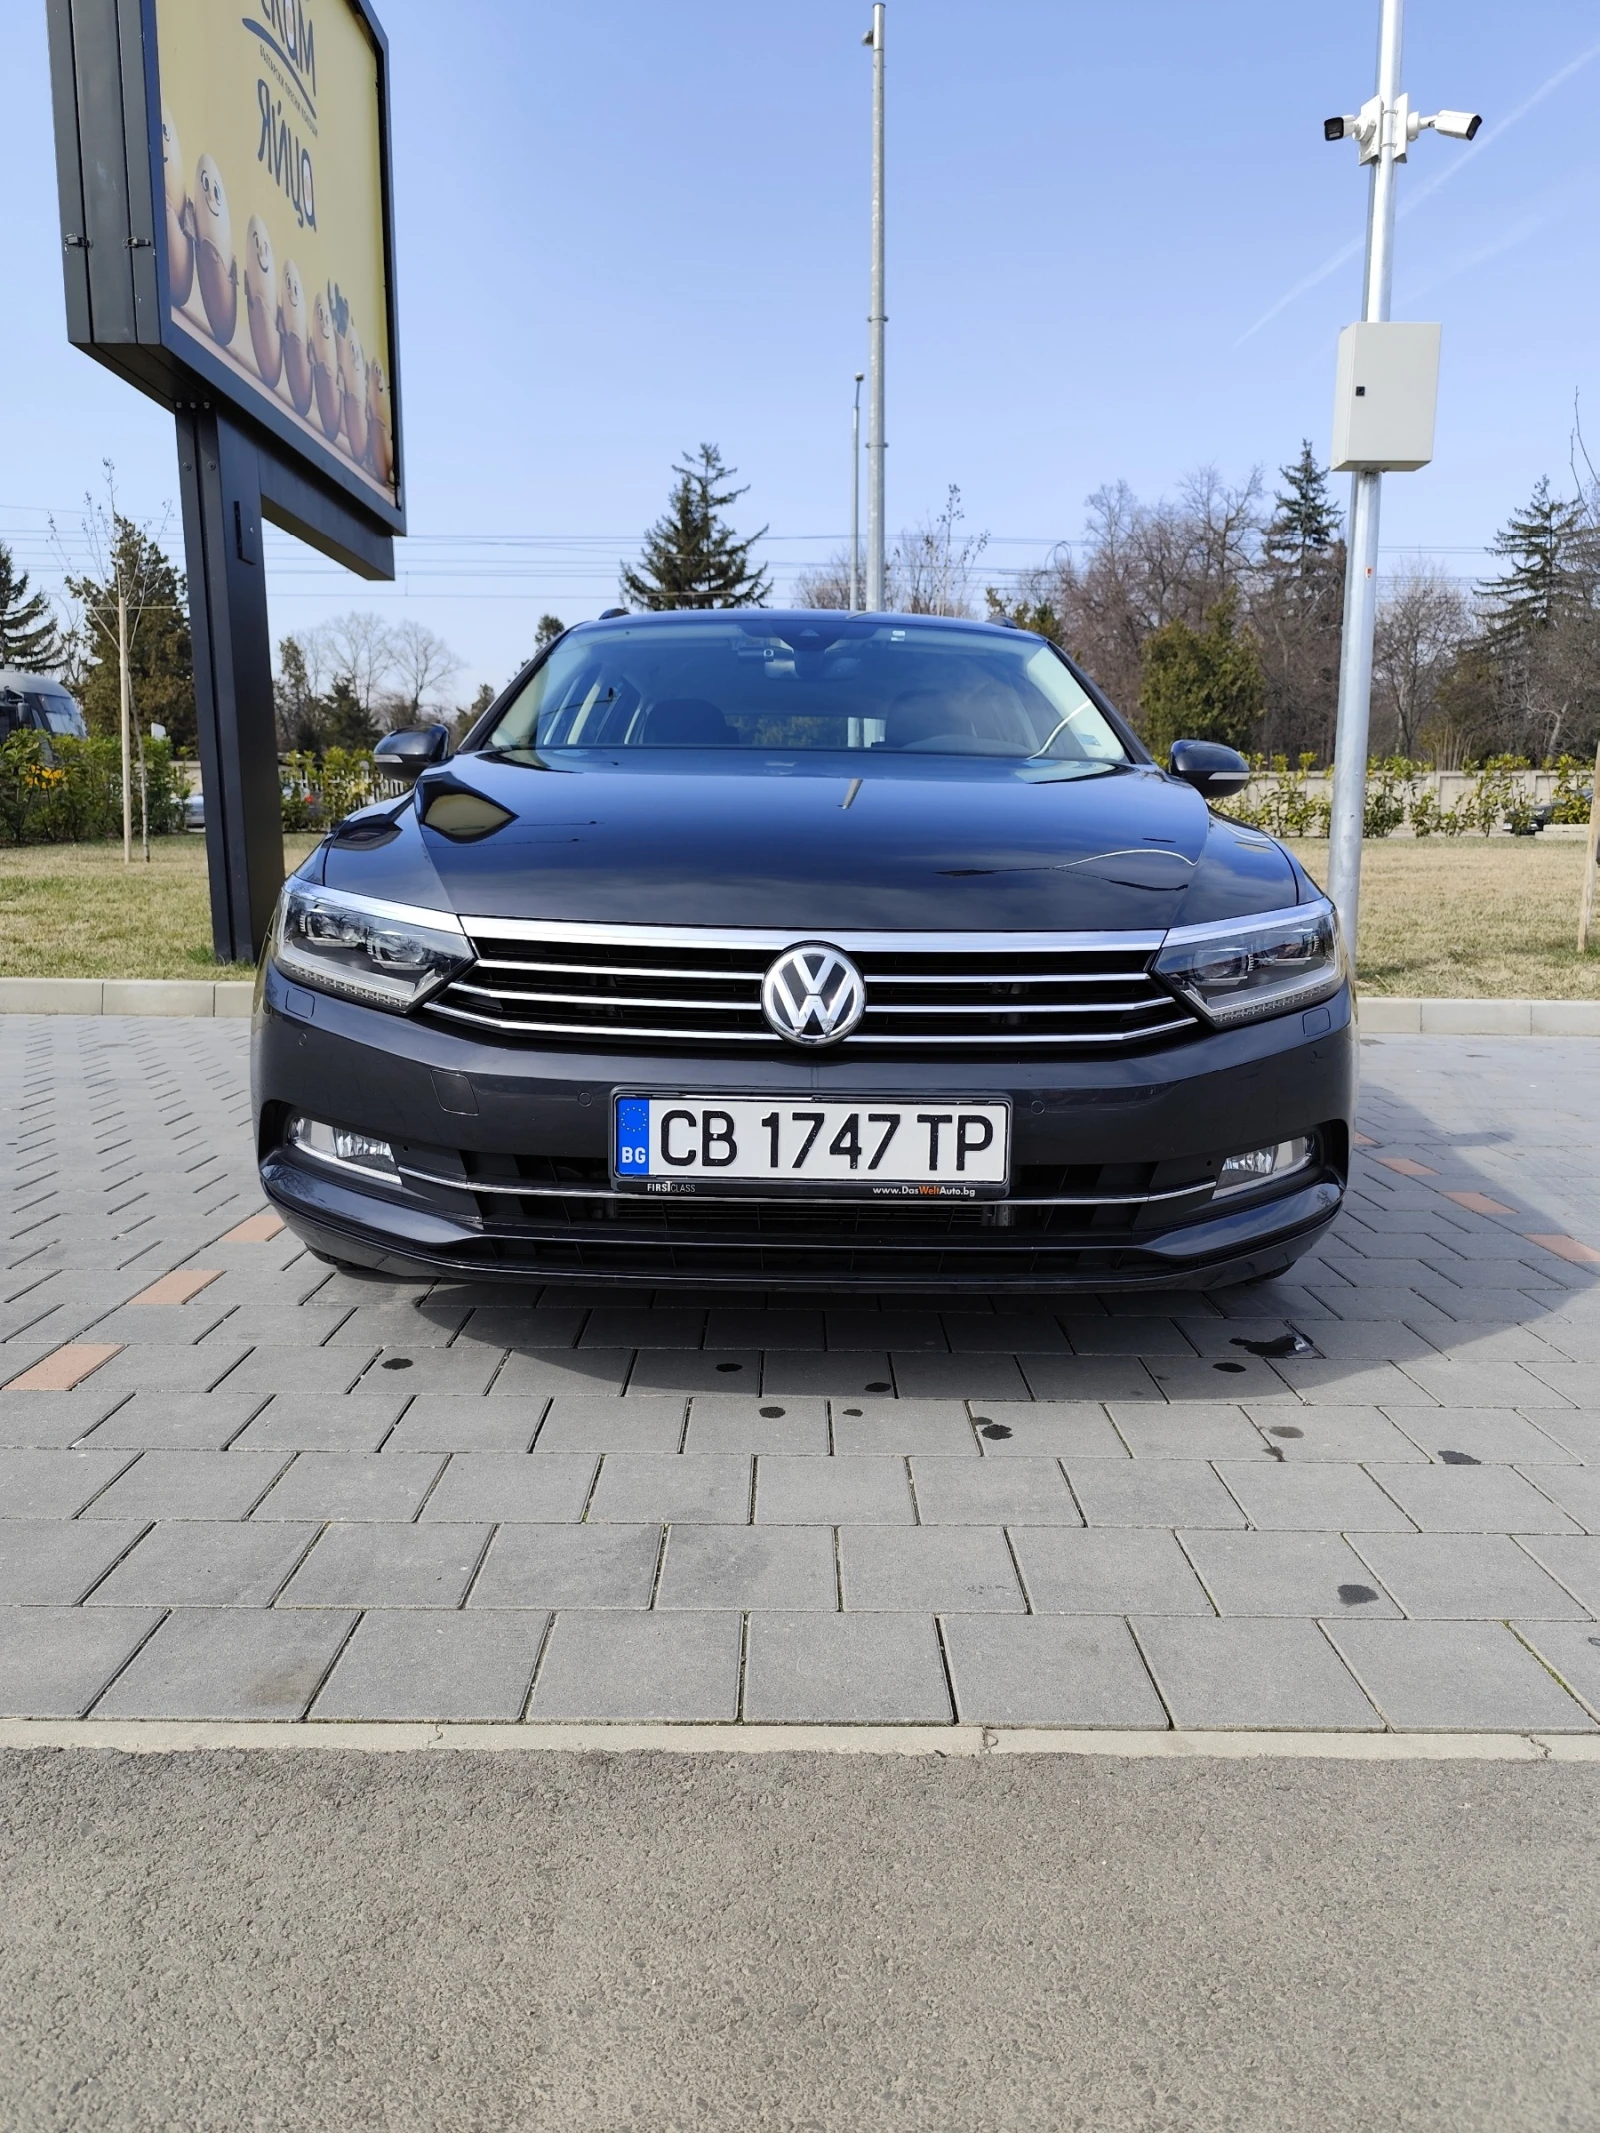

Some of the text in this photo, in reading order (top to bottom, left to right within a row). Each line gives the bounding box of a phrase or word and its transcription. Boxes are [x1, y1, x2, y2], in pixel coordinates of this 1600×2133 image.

[660, 1109, 994, 1171] CB 1747 TP
[621, 1146, 646, 1165] BG
[872, 1185, 976, 1197] www.DasWeltAuto.bg
